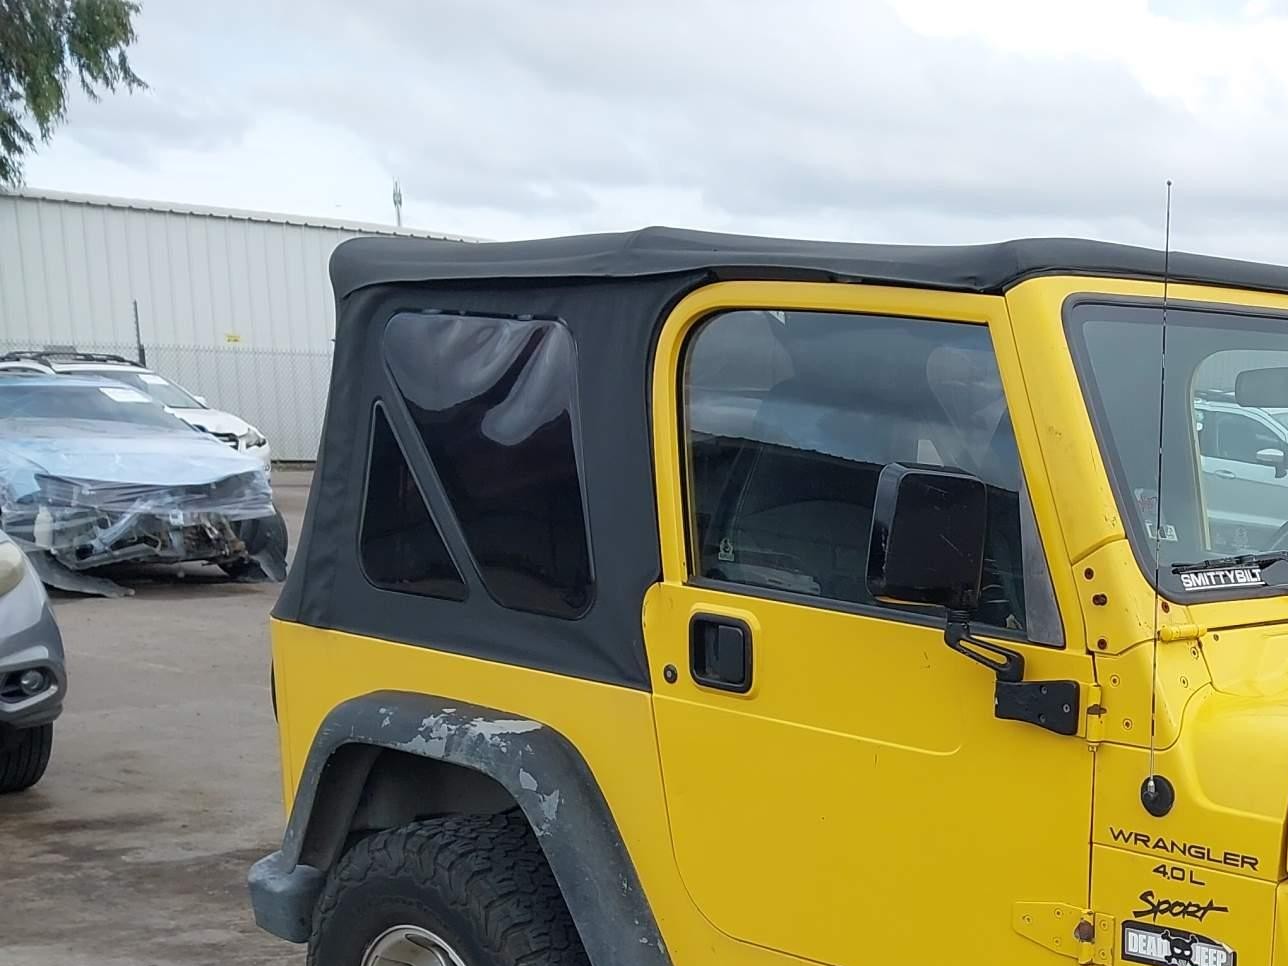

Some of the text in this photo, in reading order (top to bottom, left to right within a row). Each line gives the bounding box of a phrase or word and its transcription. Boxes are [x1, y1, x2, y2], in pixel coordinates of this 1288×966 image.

[1181, 569, 1262, 588] SMITTYBILT
[1109, 827, 1259, 871] WRANGLER
[1190, 869, 1206, 886] L
[1132, 890, 1229, 922] Sport
[1127, 931, 1172, 960] DEAD
